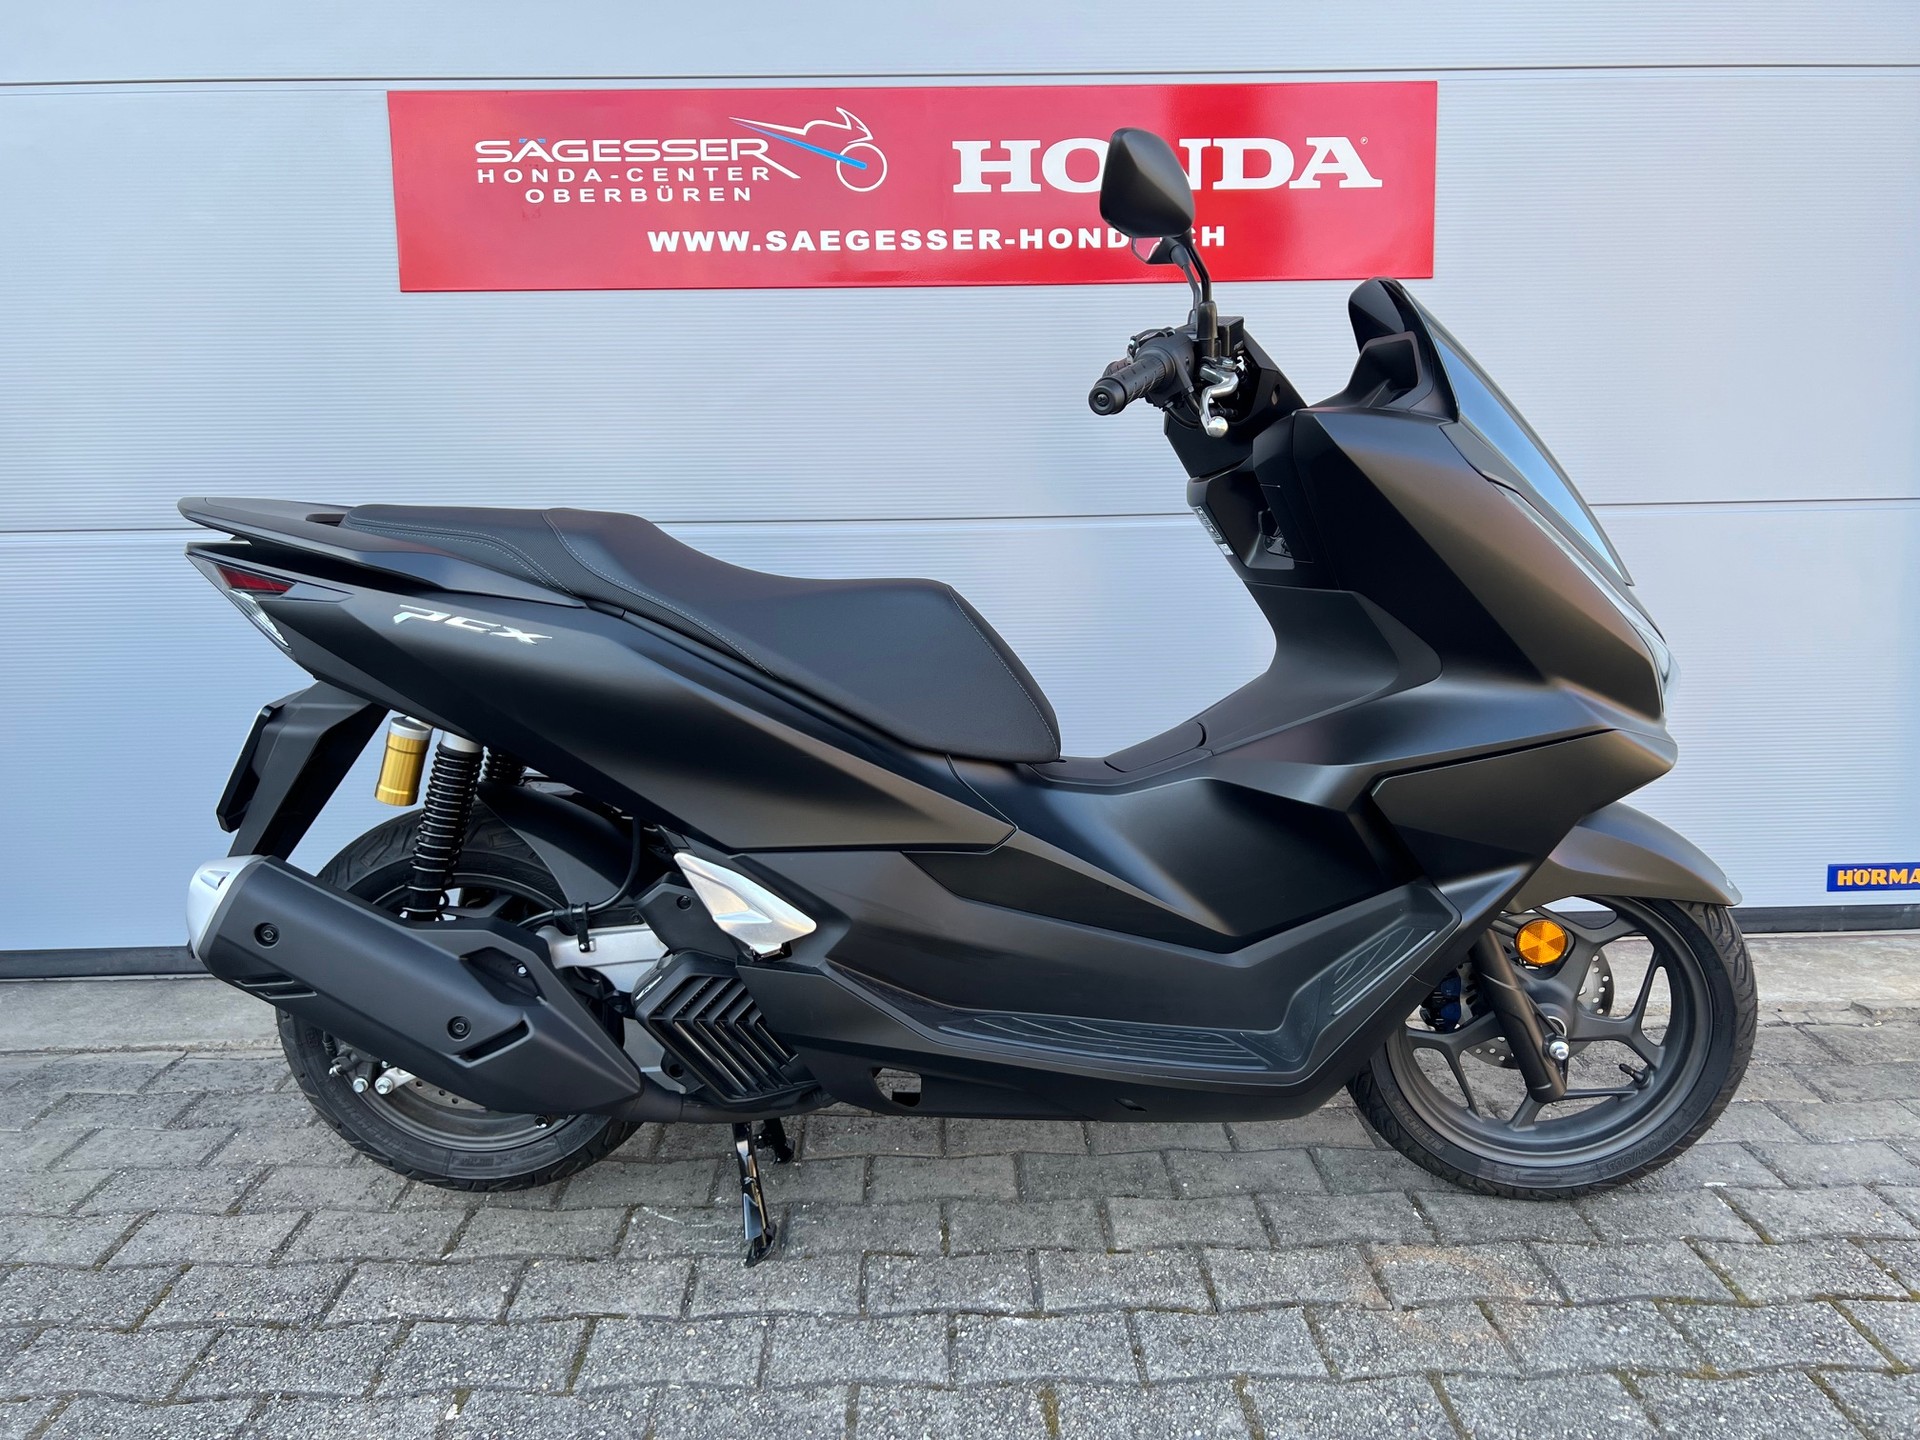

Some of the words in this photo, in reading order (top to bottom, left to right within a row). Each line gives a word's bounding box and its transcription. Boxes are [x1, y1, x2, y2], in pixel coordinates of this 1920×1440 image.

[475, 138, 800, 179] SÄGESSER
[477, 166, 770, 184] HONDA-CENTER
[524, 185, 751, 204] OBERBÜREN
[647, 226, 1225, 252] WWW.SAEGESSER-HONDH
[393, 604, 553, 646] PCX
